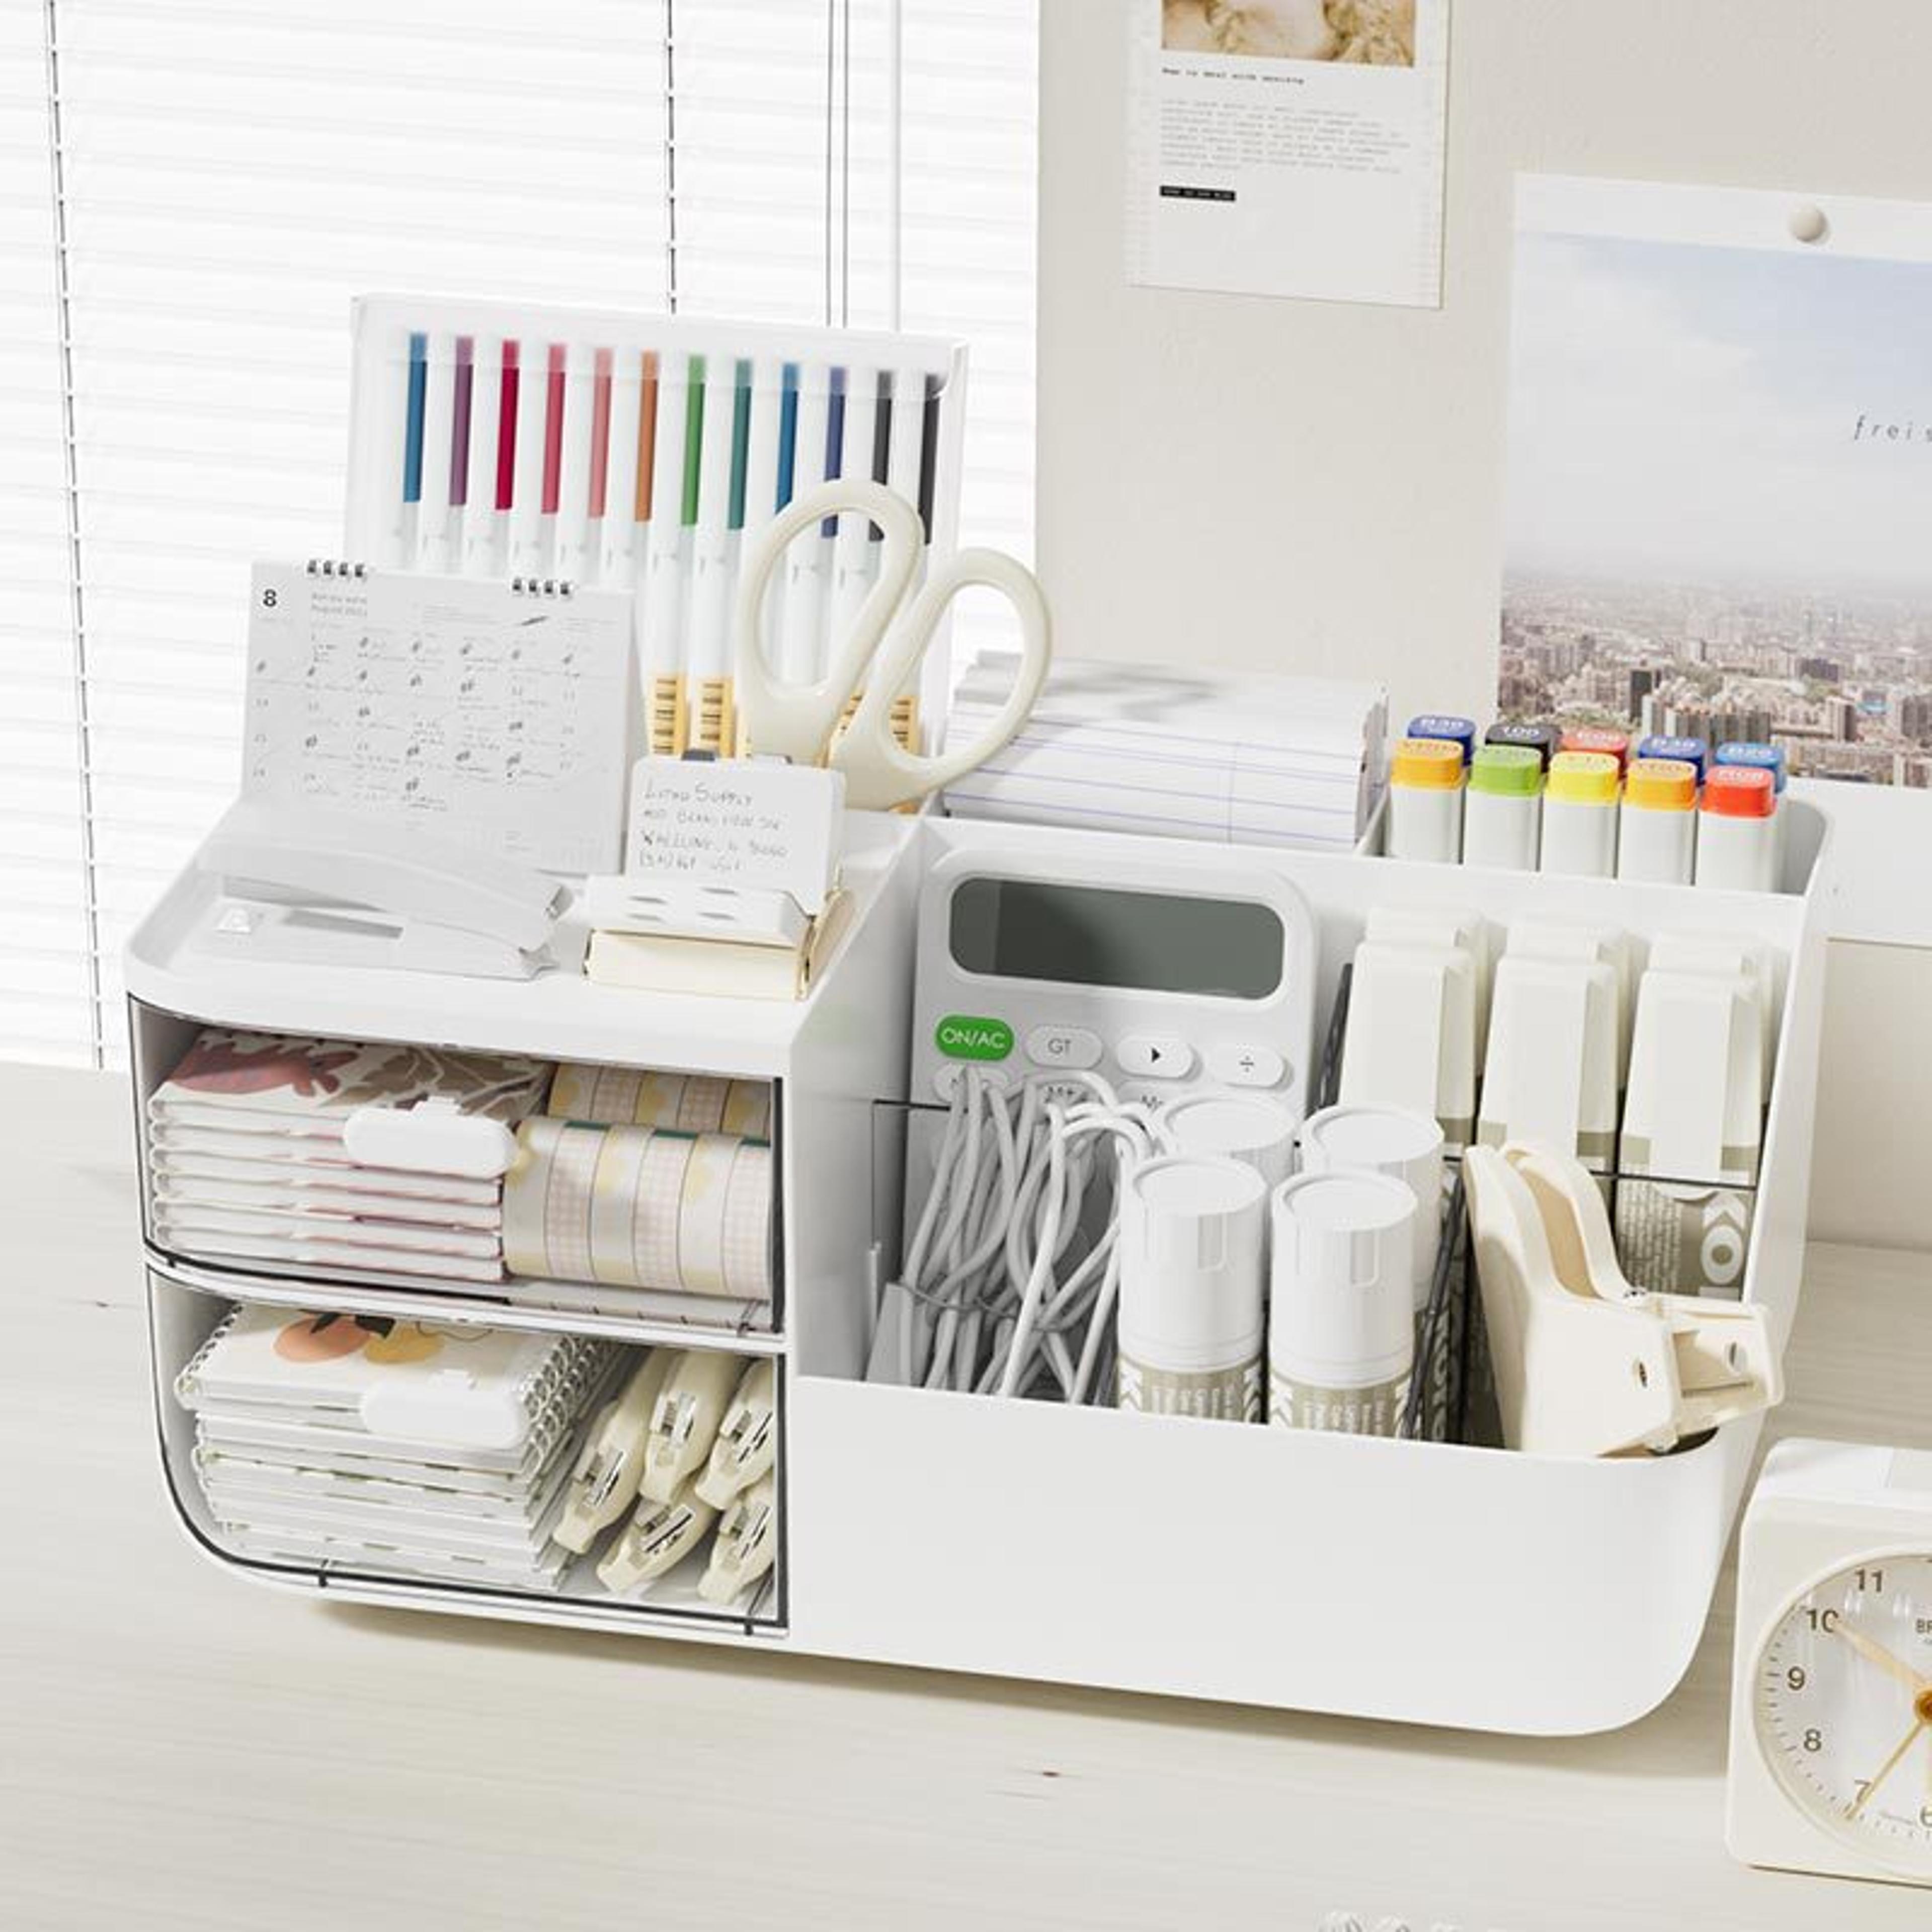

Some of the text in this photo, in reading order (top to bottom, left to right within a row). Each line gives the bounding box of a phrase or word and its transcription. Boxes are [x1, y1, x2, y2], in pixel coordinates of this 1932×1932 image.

[263, 589, 277, 607] 8
[940, 1026, 1006, 1049] ON/AC
[1047, 1037, 1072, 1054] GT
[1855, 1568, 1883, 1592] 11
[1805, 1608, 1839, 1633] 10
[1787, 1666, 1806, 1691] 9
[1803, 1729, 1822, 1752] 8
